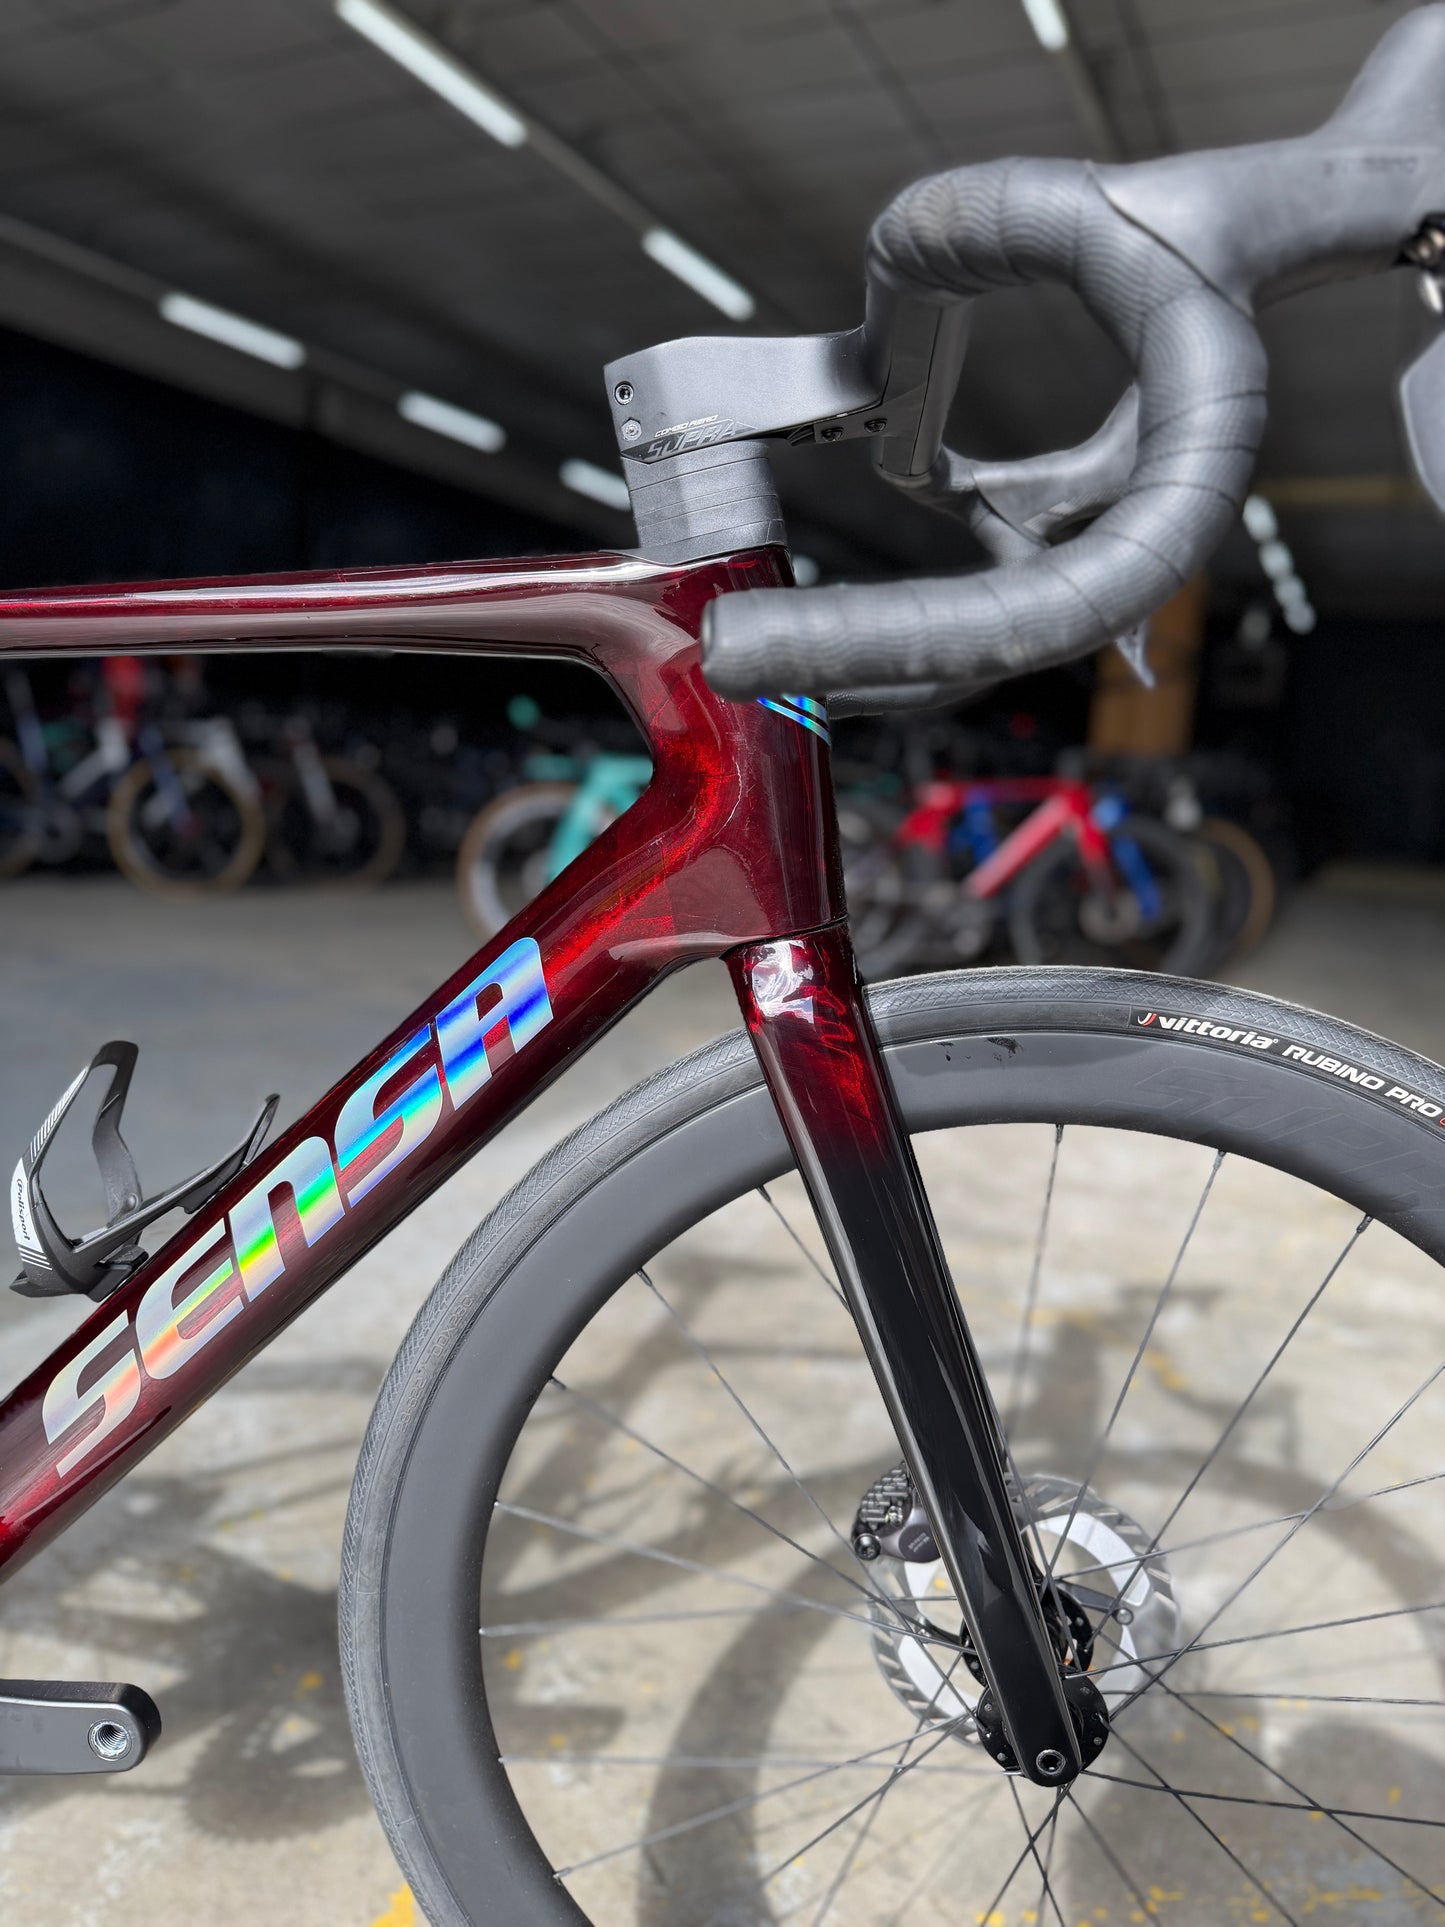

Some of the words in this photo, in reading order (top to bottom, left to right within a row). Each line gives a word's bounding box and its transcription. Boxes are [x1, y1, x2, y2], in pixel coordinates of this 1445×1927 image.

[1282, 1043, 1386, 1091] RUBINO
[1384, 1085, 1443, 1118] PRO
[16, 1178, 31, 1241] Polisport
